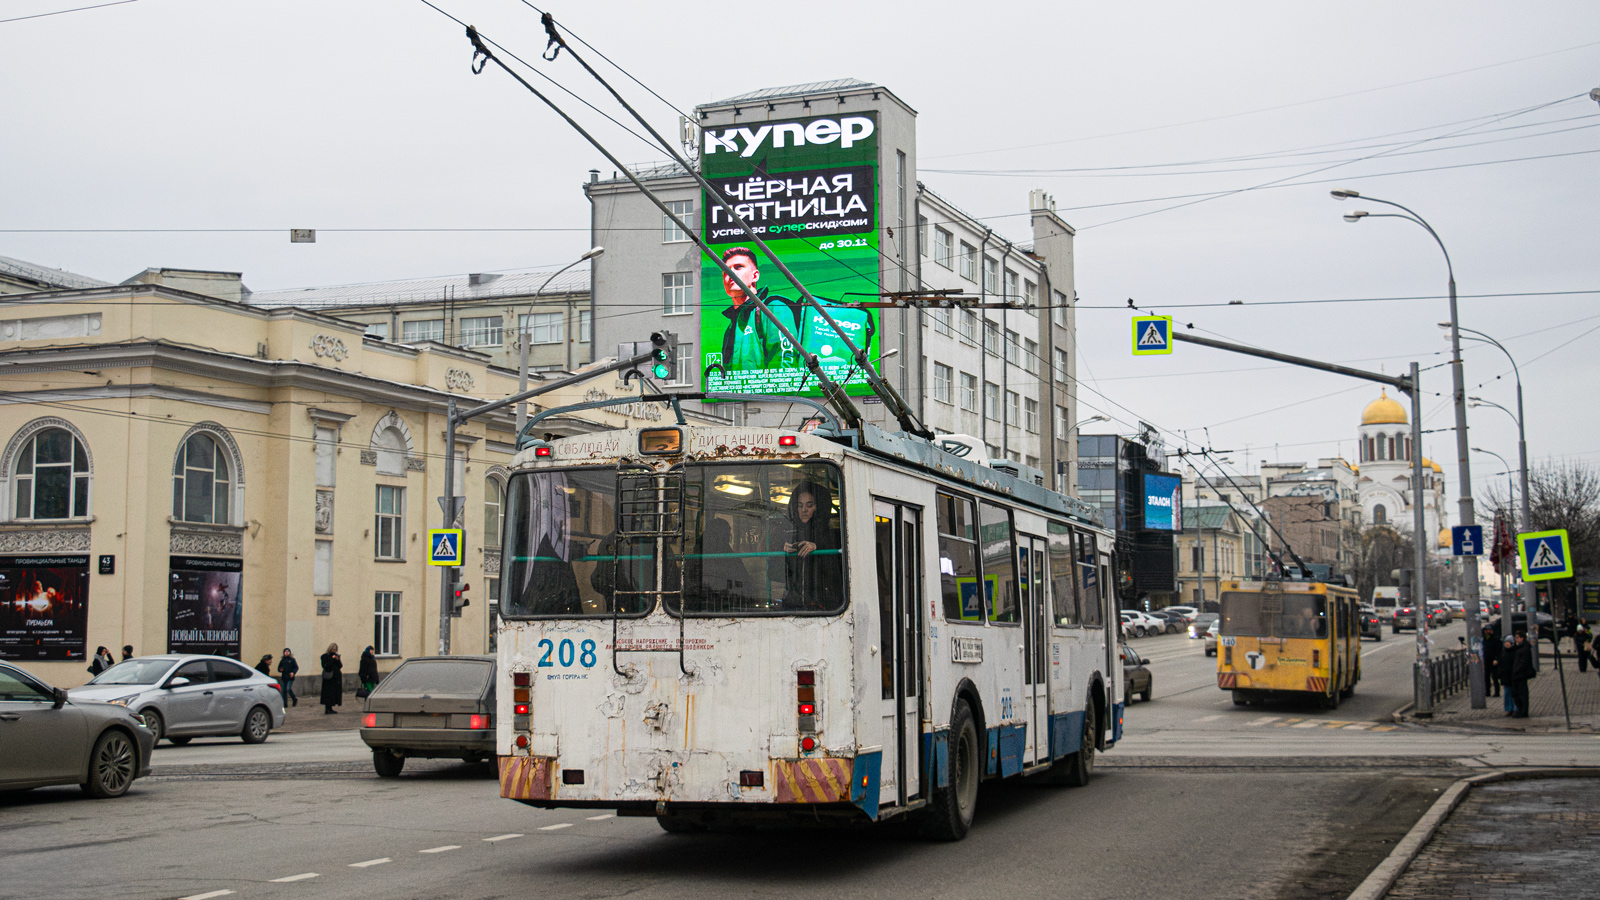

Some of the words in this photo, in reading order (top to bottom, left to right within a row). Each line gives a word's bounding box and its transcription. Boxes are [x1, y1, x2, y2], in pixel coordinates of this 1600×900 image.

[704, 116, 875, 158] купер
[724, 173, 853, 201] ЧЁРНАЯ
[711, 194, 868, 224] ПЯТНИЦА
[768, 218, 868, 234] суперскидками
[819, 240, 835, 250] до
[836, 238, 868, 248] 30.11
[708, 354, 721, 366] 12+
[558, 439, 620, 456] СОБЛЮДАЙ
[698, 433, 774, 448] ДИСТАНЦИЮ
[102, 556, 111, 564] 43
[171, 628, 198, 641] НОВЫЙ
[538, 638, 597, 668] 208
